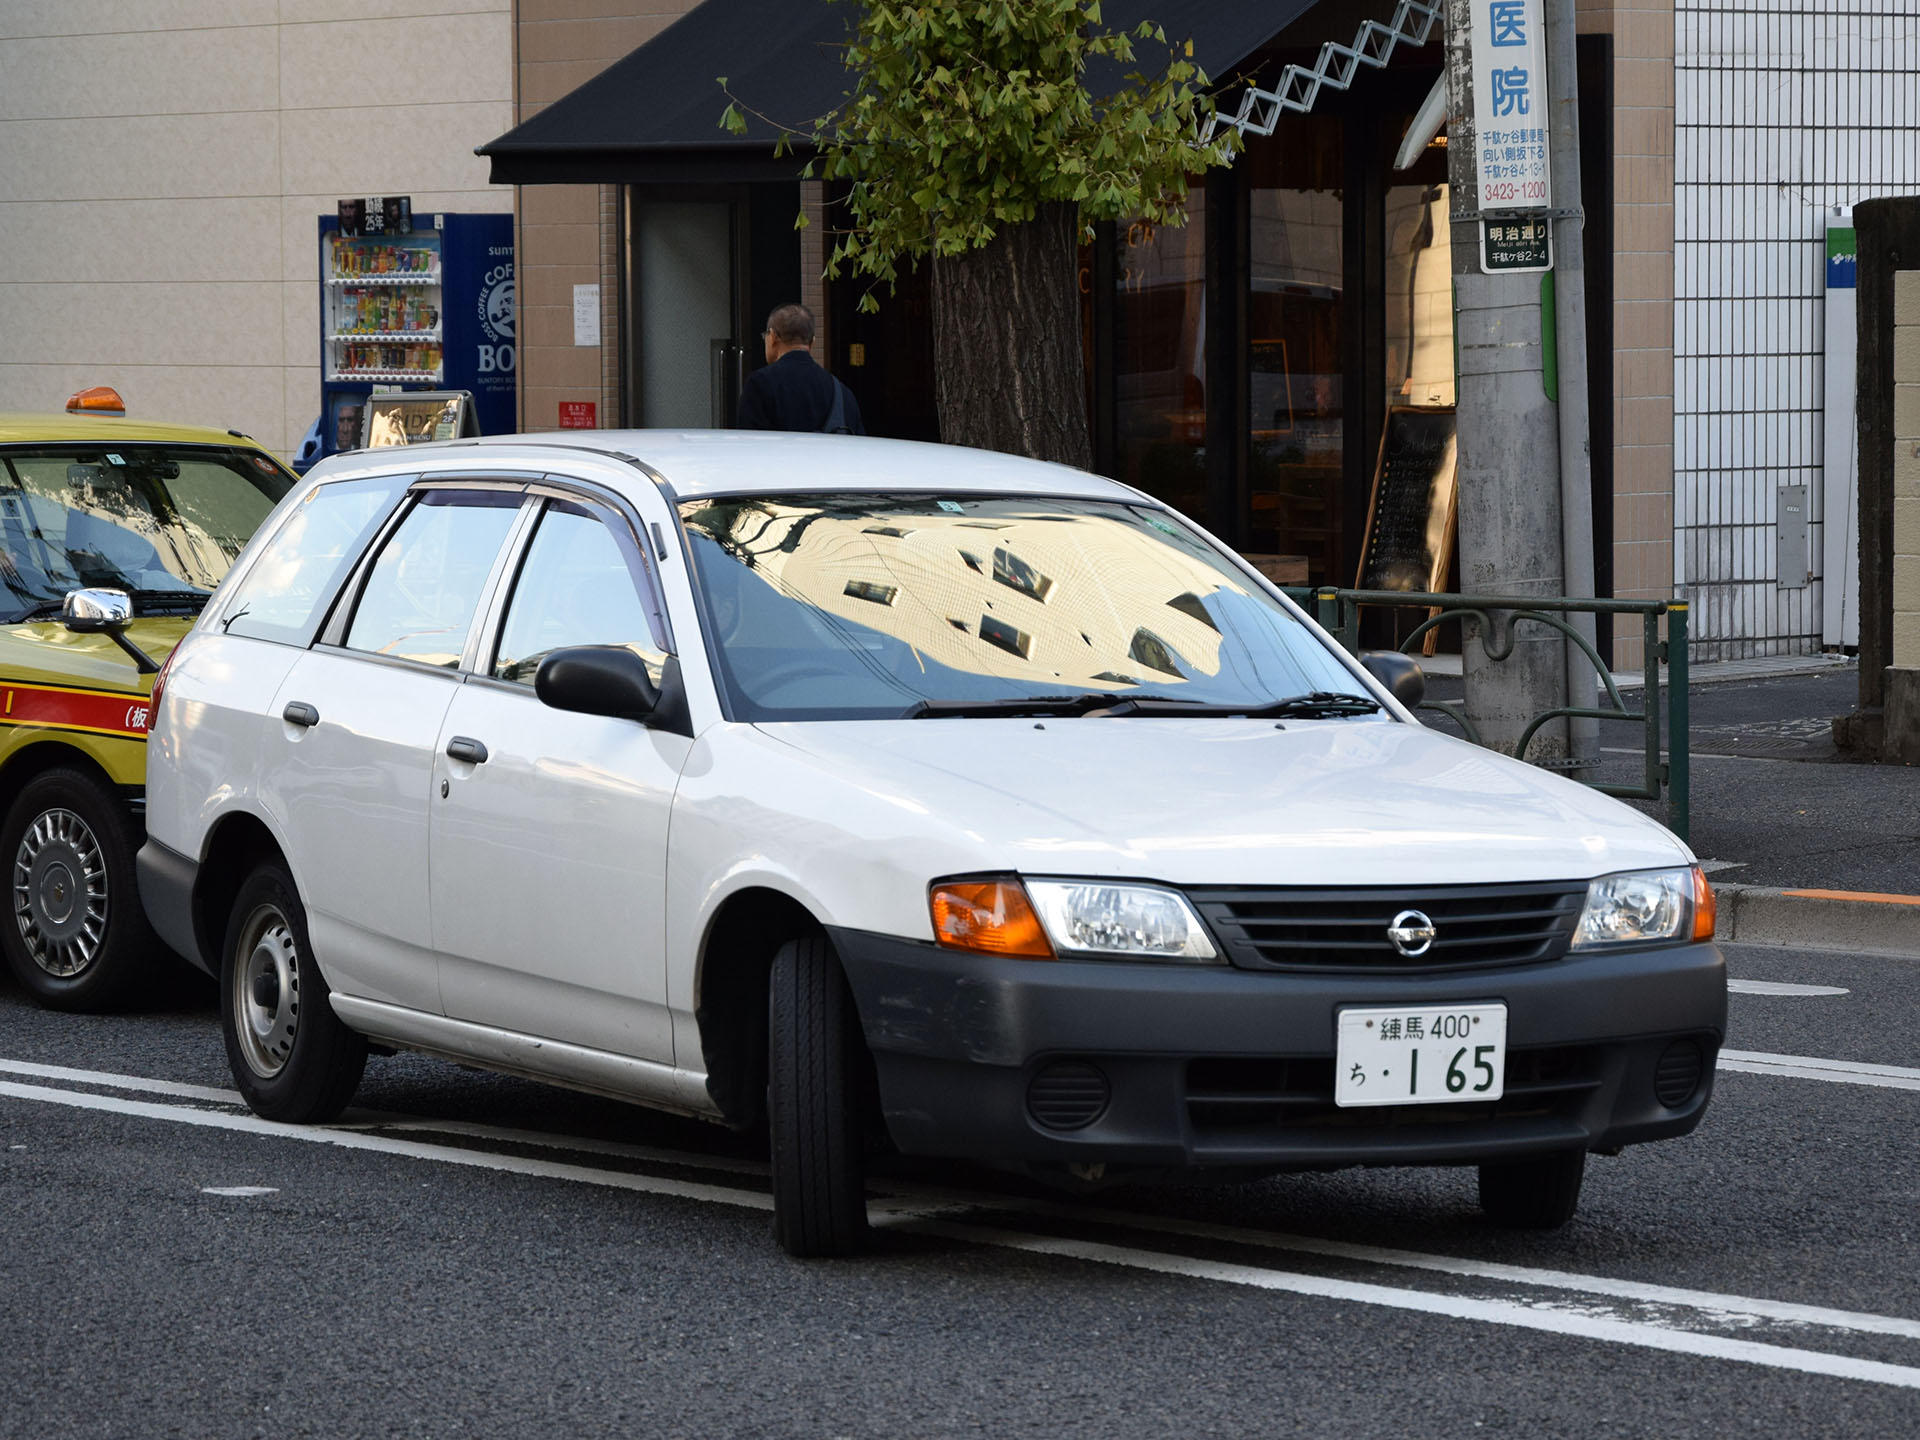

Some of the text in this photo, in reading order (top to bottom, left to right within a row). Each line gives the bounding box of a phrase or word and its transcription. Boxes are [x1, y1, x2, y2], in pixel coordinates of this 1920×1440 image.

[1490, 1, 1530, 117] 医院
[1483, 145, 1545, 162] 向い側坂下る
[1485, 180, 1547, 201] 3423-1200
[365, 215, 384, 231] 25年
[1489, 225, 1546, 241] 明治通り
[485, 263, 515, 286] COF
[477, 286, 490, 321] COFFEE
[442, 415, 454, 423] 2F
[1380, 1014, 1470, 1041] 練馬 400
[1349, 1062, 1366, 1087] ち
